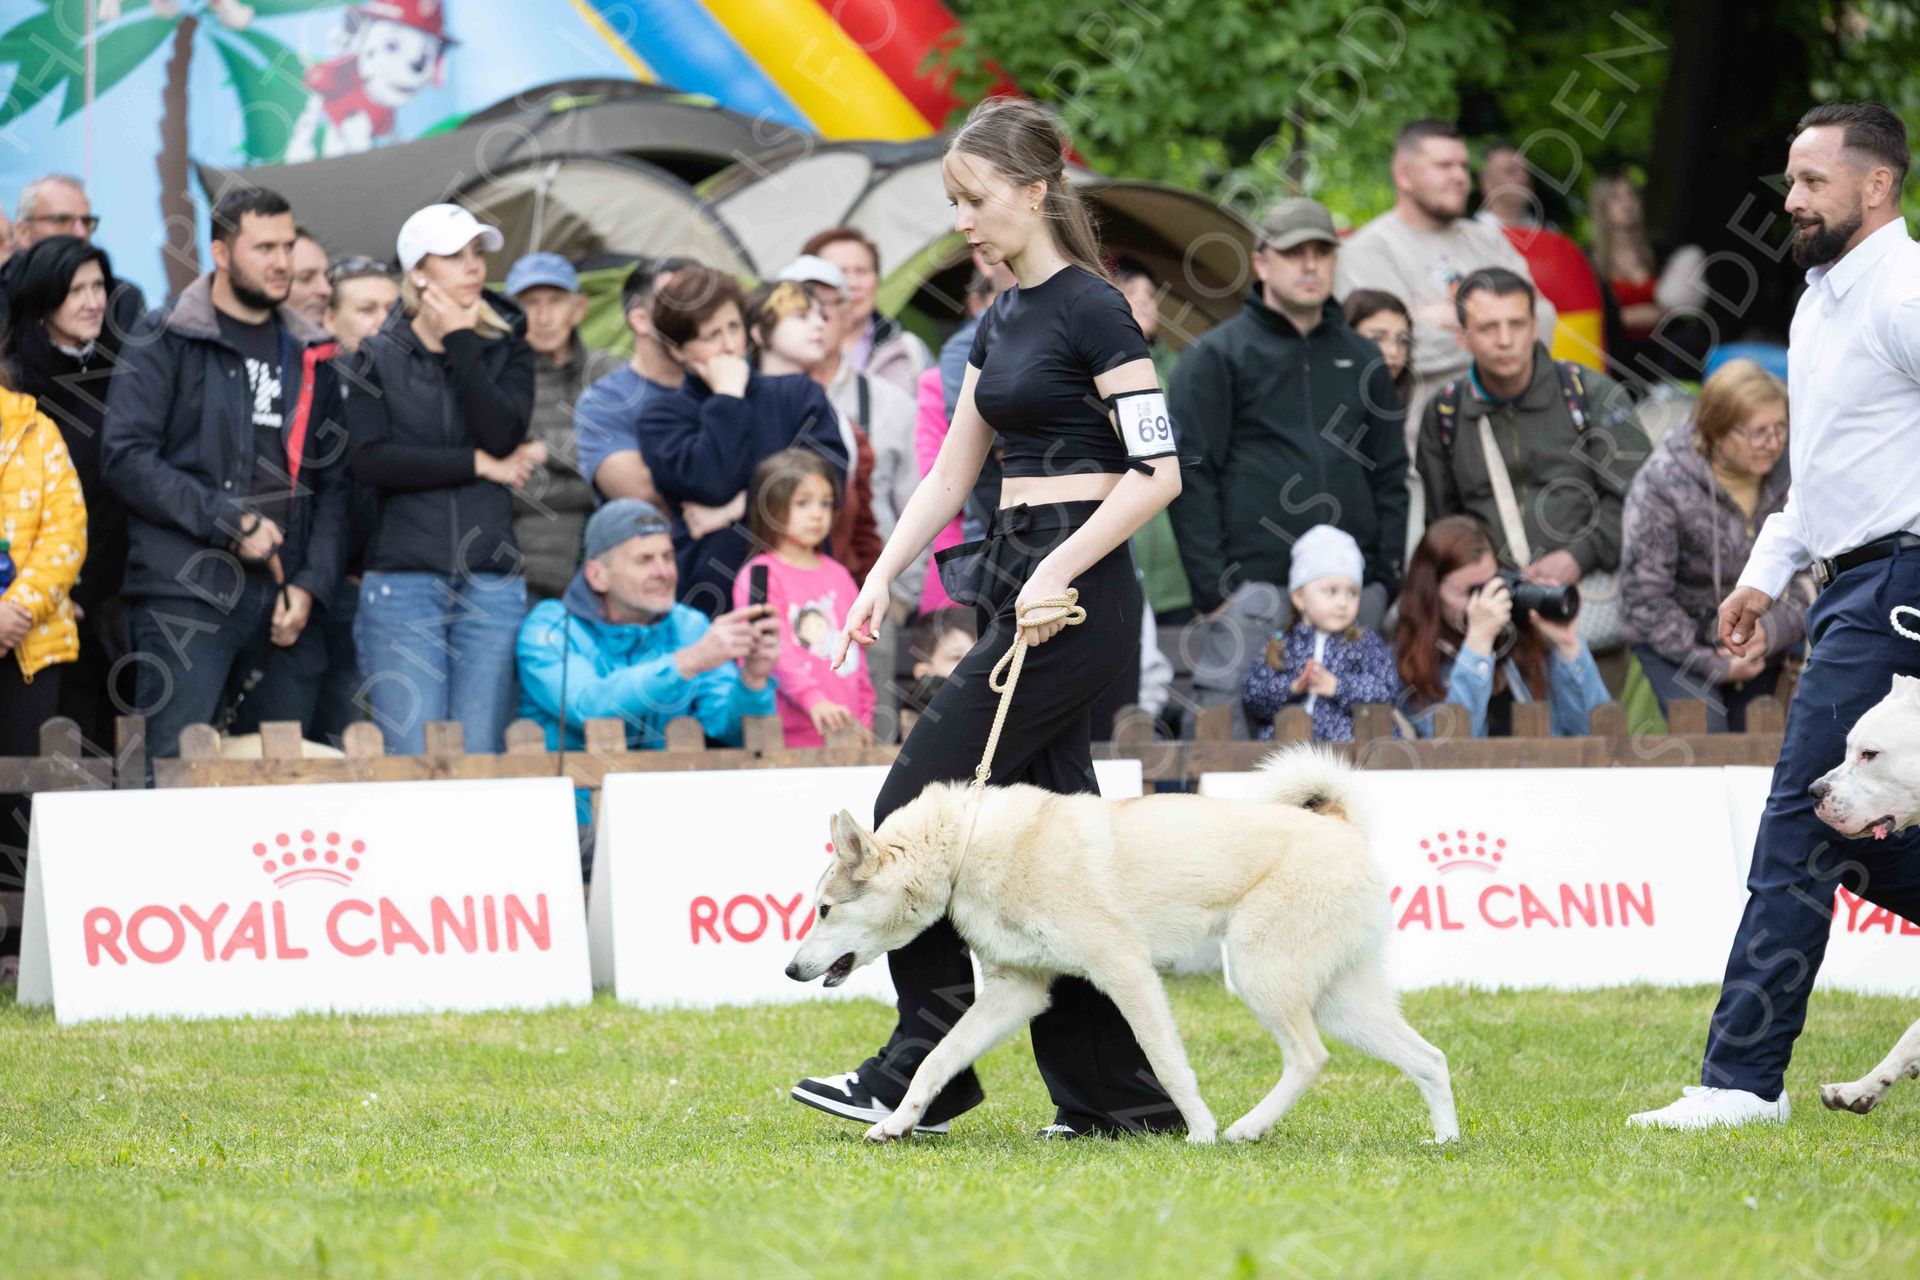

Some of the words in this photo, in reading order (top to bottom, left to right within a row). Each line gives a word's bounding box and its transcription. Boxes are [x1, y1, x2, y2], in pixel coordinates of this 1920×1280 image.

[1138, 415, 1169, 443] 69
[1478, 881, 1655, 929] CANIN
[83, 900, 309, 967] ROYAL
[325, 893, 551, 957] CANIN
